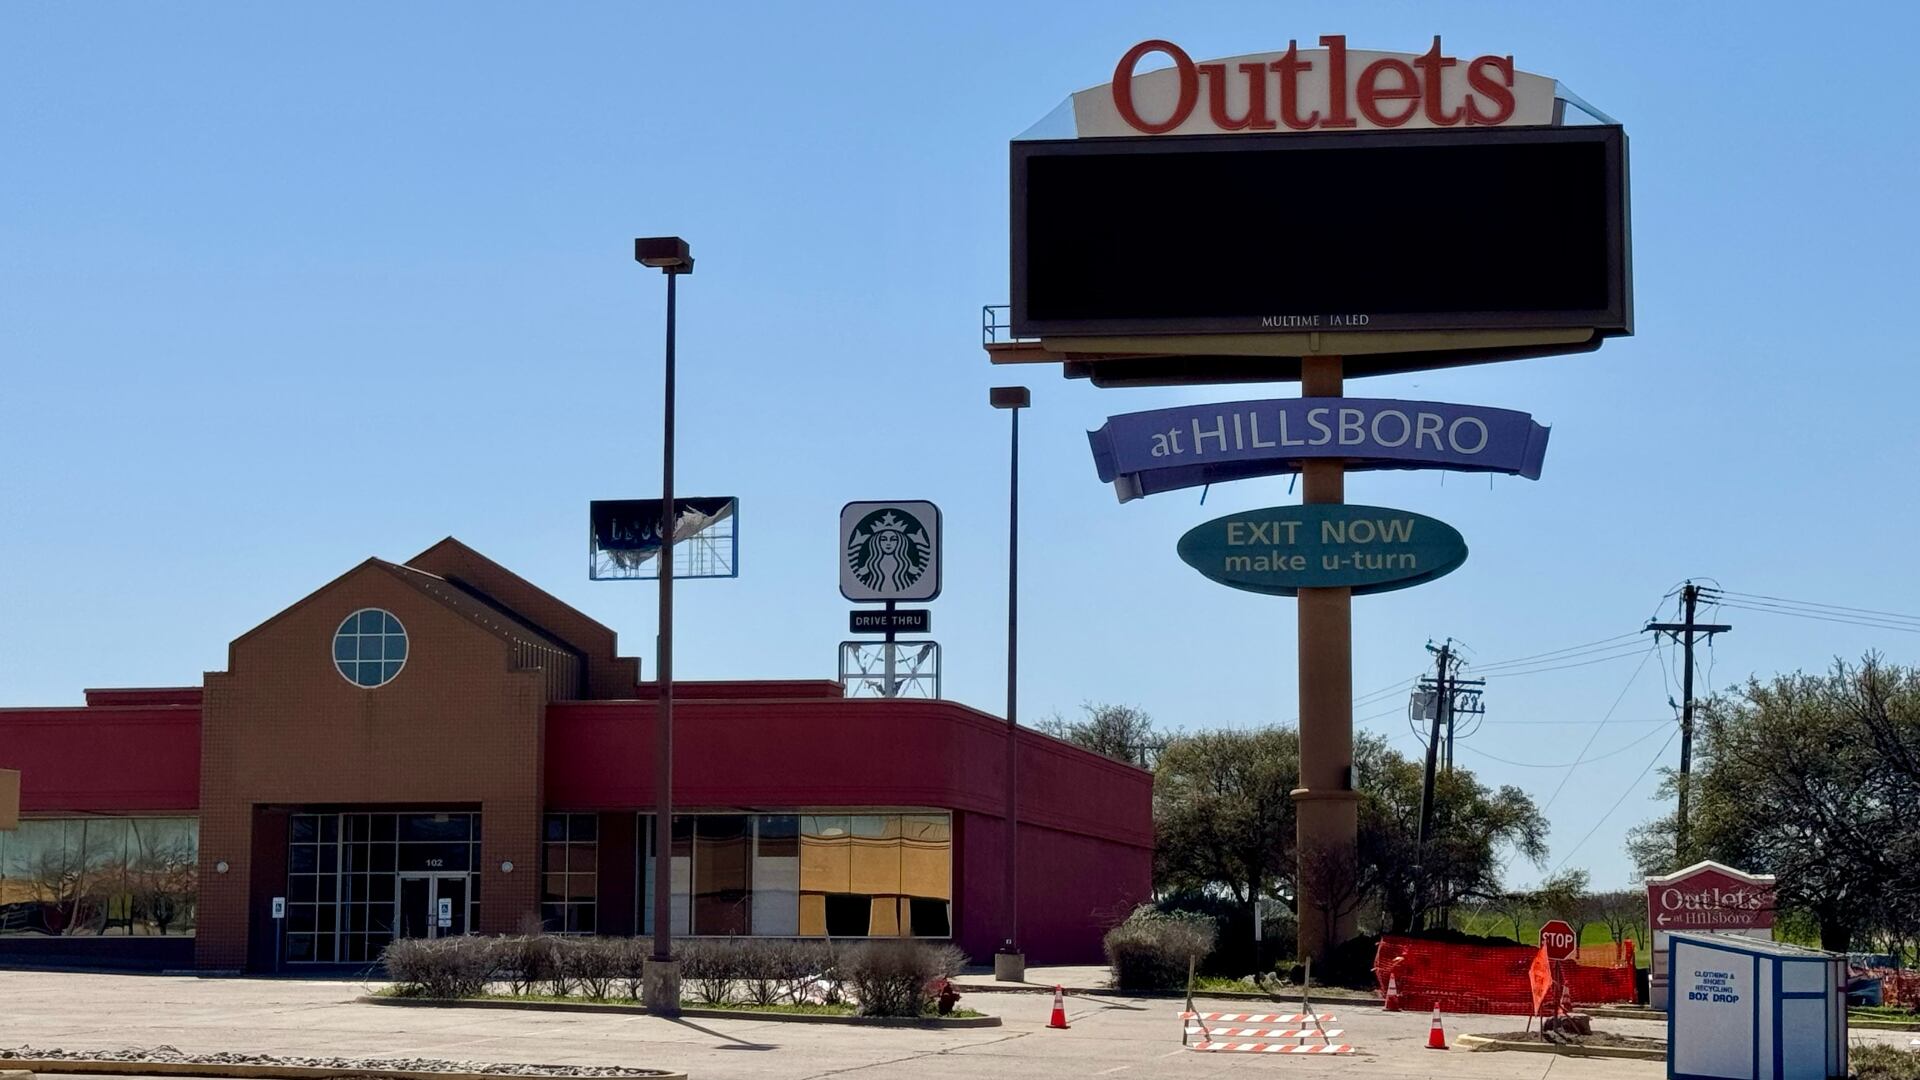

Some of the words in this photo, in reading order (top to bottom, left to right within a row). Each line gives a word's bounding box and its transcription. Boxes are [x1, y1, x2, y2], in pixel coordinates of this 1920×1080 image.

[1112, 34, 1516, 135] Outlets
[1345, 314, 1369, 325] LED
[1151, 427, 1184, 457] at
[1191, 408, 1489, 455] HILLSBORO
[1227, 521, 1303, 546] EXIT
[1321, 519, 1415, 544] NOW
[1225, 550, 1307, 572] make
[1322, 551, 1417, 570] u-turn
[855, 616, 887, 626] DRIVE
[892, 616, 921, 625] THRU
[426, 859, 444, 867] 102
[1661, 888, 1761, 910] Outlets
[1686, 912, 1751, 924] Hillsboro
[1542, 932, 1574, 949] STOP
[1689, 992, 1709, 1001] BOX
[1712, 994, 1739, 1004] DROP
